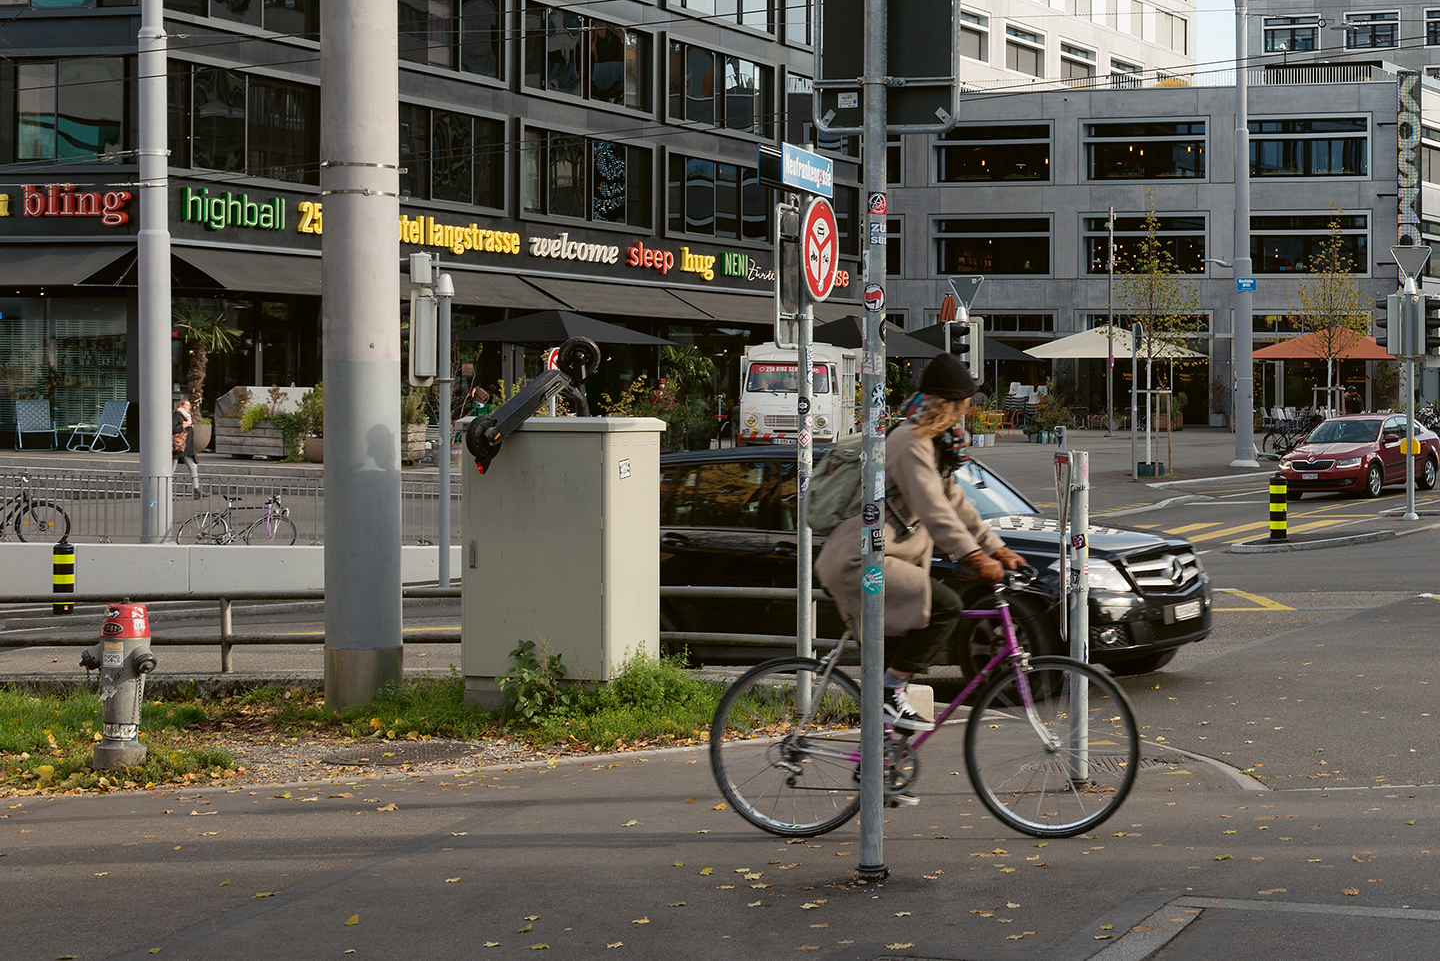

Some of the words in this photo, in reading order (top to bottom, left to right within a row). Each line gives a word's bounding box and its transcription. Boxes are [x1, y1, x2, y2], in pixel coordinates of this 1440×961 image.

[20, 182, 132, 226] bling
[181, 186, 286, 230] highball
[425, 216, 521, 255] langstrasse
[528, 232, 620, 265] welcome
[626, 241, 675, 275] sleep
[679, 246, 716, 282] hug
[721, 251, 749, 277] NENI
